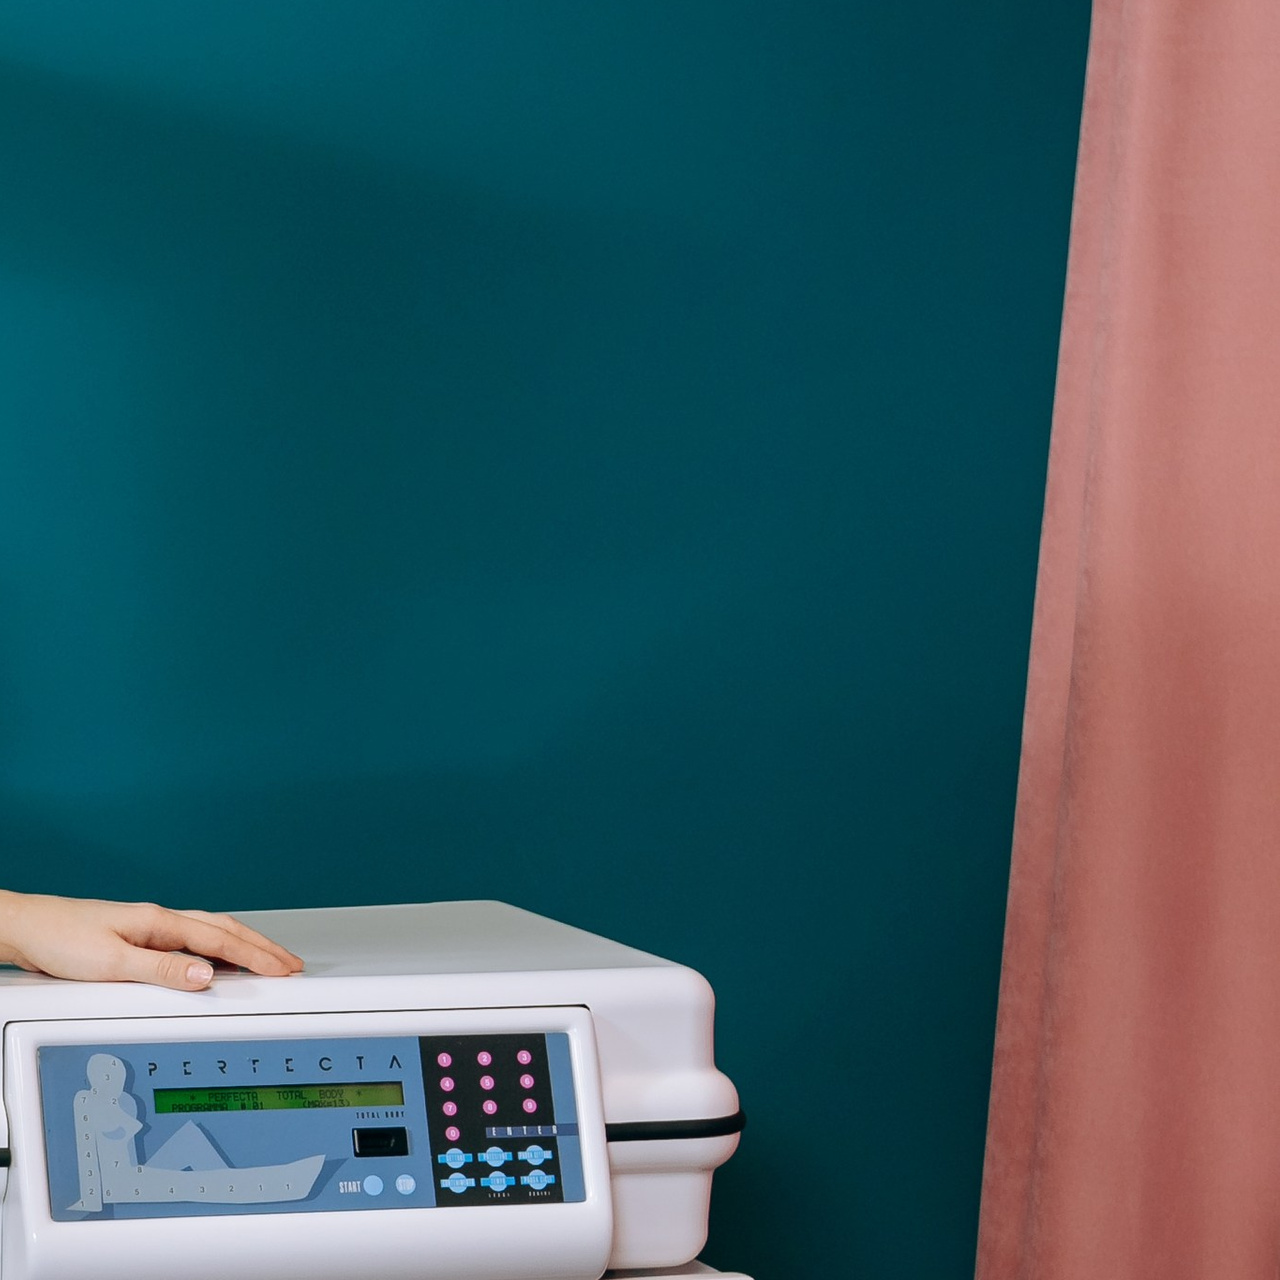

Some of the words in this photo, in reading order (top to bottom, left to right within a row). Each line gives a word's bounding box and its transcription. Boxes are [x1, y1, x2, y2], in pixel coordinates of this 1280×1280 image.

[148, 1054, 402, 1076] PERFECTA
[208, 1091, 259, 1102] PERFECTA
[277, 1089, 307, 1100] TOTAL
[319, 1088, 345, 1099] BODY
[171, 1102, 229, 1113] PROGRAMMA
[355, 1112, 380, 1120] TOTAL
[385, 1110, 405, 1119] BODY
[492, 1125, 558, 1136] ENTER
[339, 1180, 361, 1193] START
